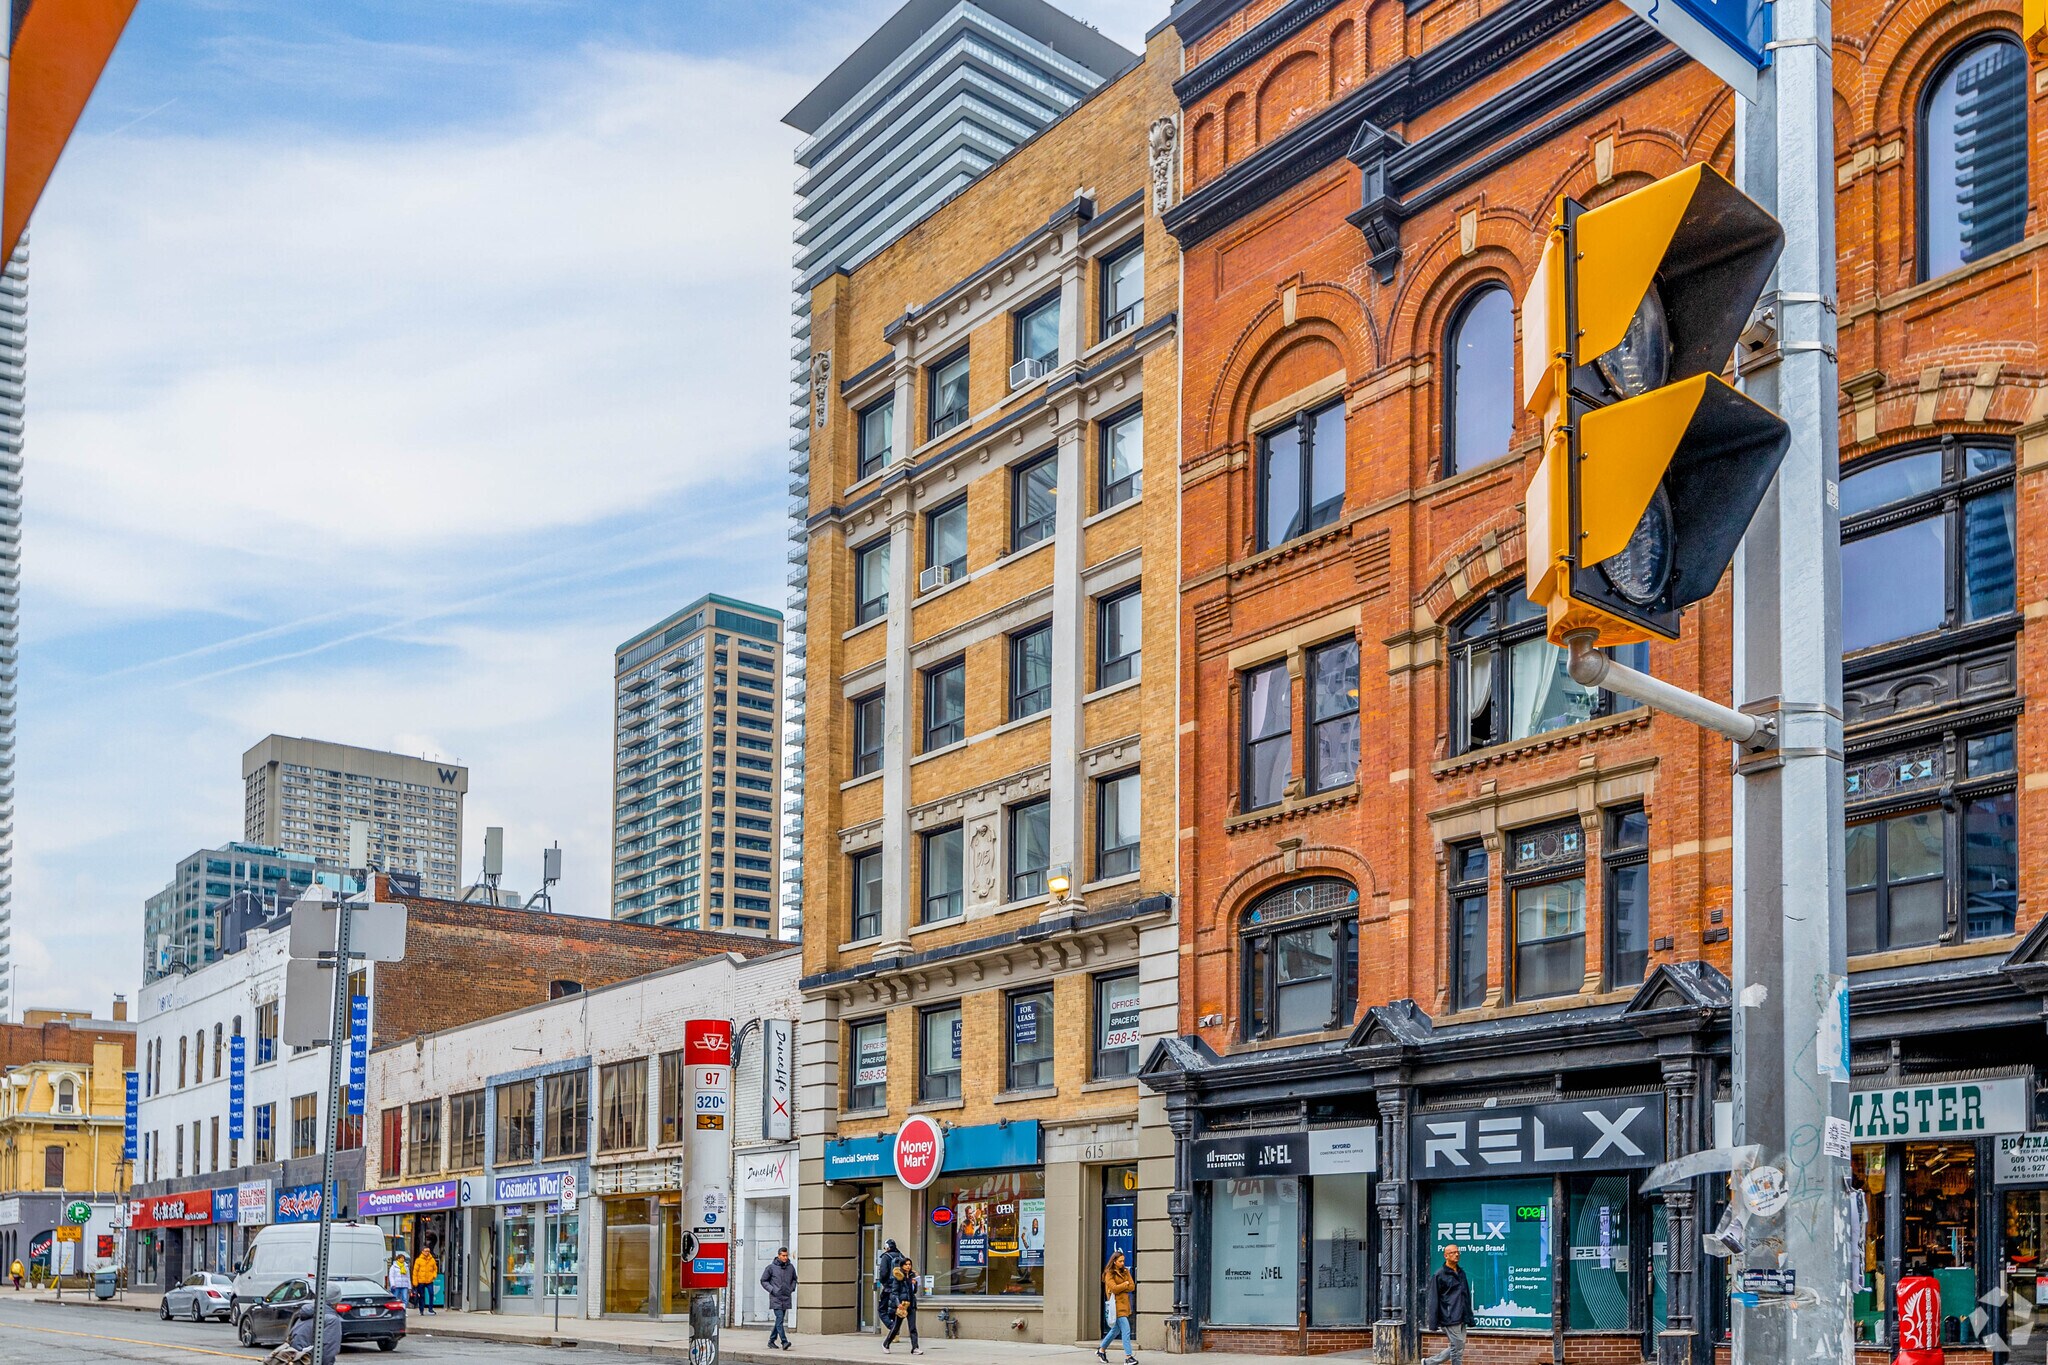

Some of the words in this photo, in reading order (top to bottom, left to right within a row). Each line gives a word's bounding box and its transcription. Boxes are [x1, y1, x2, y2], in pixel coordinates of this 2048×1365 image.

[438, 768, 457, 784] W
[1020, 1006, 1032, 1014] FOR
[1018, 1013, 1035, 1022] LEASE
[1111, 1017, 1130, 1026] SPACE
[862, 1056, 876, 1065] SPACE
[705, 1072, 720, 1085] 97
[697, 1095, 719, 1108] 320
[1425, 1106, 1645, 1168] RELX
[2001, 1136, 2048, 1150] BOTMA
[900, 1140, 933, 1155] Money
[1085, 1145, 1104, 1159] 615
[832, 1154, 856, 1164] Financial
[856, 1152, 880, 1163] Services
[1214, 1153, 1245, 1162] TRICON
[2011, 1156, 2025, 1164] 609
[500, 1177, 537, 1199] Cosmetic
[539, 1174, 563, 1195] Worl
[215, 1190, 233, 1210] hone
[369, 1189, 413, 1206] Cosmetic
[415, 1185, 445, 1201] World
[997, 1204, 1014, 1214] OPEN
[1112, 1218, 1128, 1227] FOR
[1243, 1212, 1263, 1226] IVY
[1108, 1228, 1132, 1237] LEASE
[1437, 1222, 1506, 1240] RELX
[1467, 1245, 1484, 1253] Vape
[1485, 1244, 1505, 1252] Brand
[1576, 1248, 1612, 1257] RELX
[1475, 1318, 1511, 1327] ORONTO
